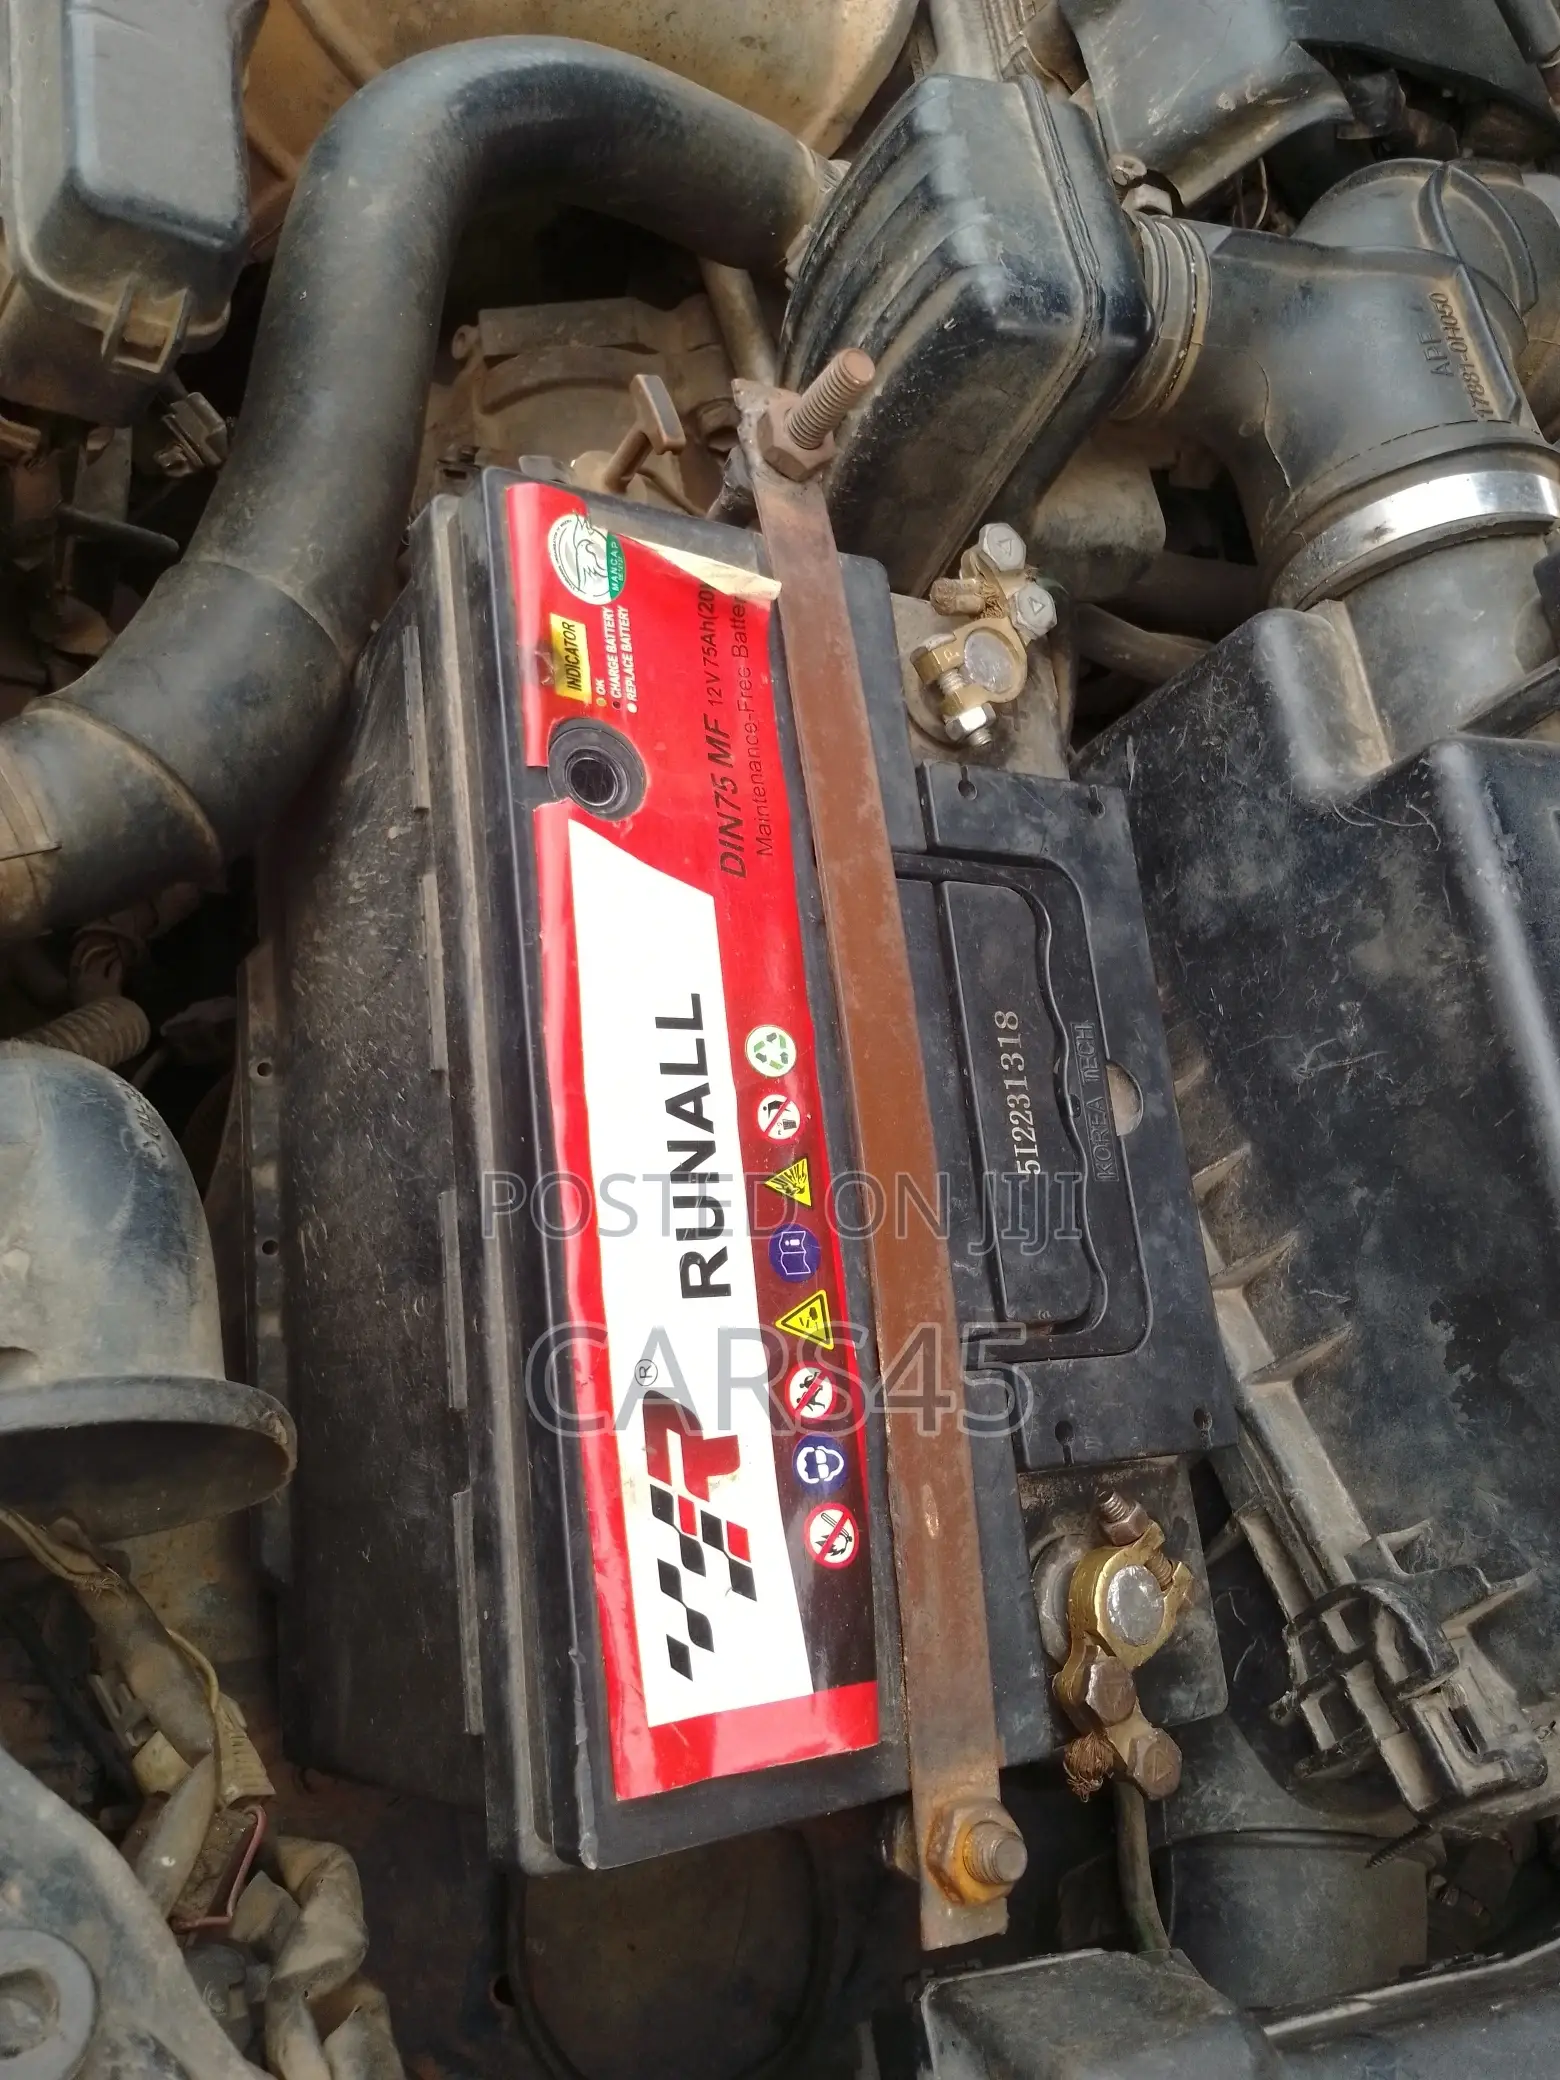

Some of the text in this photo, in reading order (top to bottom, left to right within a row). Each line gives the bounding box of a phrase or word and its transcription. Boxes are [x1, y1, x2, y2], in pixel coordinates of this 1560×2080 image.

[609, 541, 620, 591] MANCAP
[561, 621, 583, 692] INDICATOR
[595, 678, 606, 696] OK
[601, 605, 622, 699] CHARGE BATTERY
[616, 604, 638, 702] REPLACE BATTERY
[702, 670, 723, 706] 12V
[703, 712, 734, 769] MF
[737, 667, 774, 857] Maintenance-Free
[710, 772, 747, 879] DIN75
[654, 993, 732, 1300] RUNALL
[1086, 1096, 1116, 1181] KOREA
